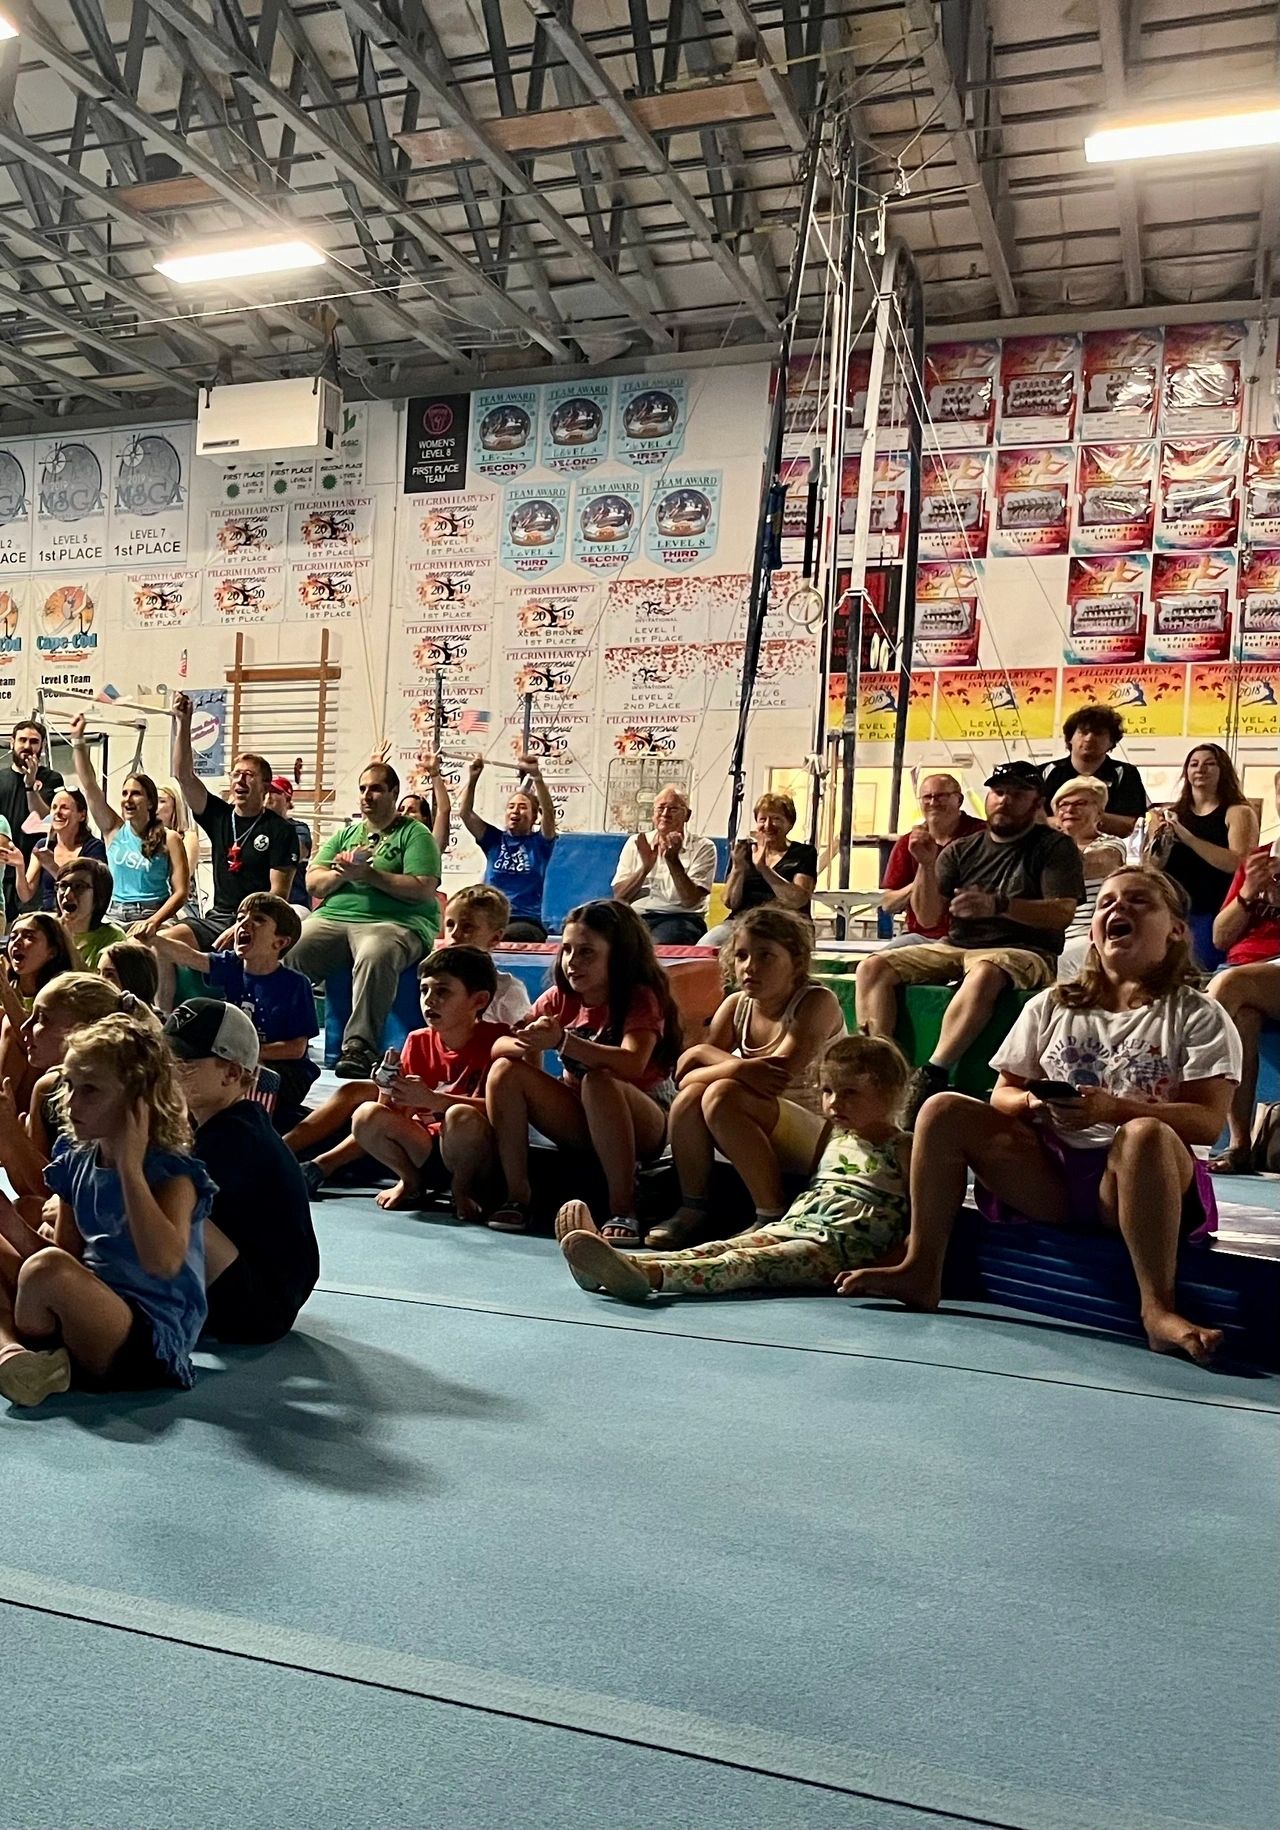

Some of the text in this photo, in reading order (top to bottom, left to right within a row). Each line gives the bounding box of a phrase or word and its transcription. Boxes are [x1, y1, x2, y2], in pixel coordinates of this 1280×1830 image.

[419, 439, 456, 449] WOMEN'S
[422, 450, 444, 459] LEVEL
[271, 469, 289, 477] FIRST
[412, 464, 459, 475] FIRST PLACE
[223, 473, 241, 481] FIRST
[425, 475, 445, 483] TEAM
[657, 476, 718, 489] TEAM AWARD
[580, 483, 640, 493] TEAM AWARD
[434, 519, 474, 531] 20 19
[130, 528, 165, 539] LEVEL 7
[6, 540, 12, 549] 2
[53, 534, 87, 545] LEVEL 5
[39, 547, 102, 562] 1st PLACE
[114, 542, 181, 557] 1st PLACE
[662, 550, 699, 559] THIRD
[410, 559, 491, 571] PILGRIM HARVEST
[514, 559, 548, 567] THIRD
[580, 555, 629, 564] SECOND
[430, 583, 471, 595] 20 19
[510, 585, 595, 596] PILGRIM HARVEST
[532, 609, 574, 621] 20 19
[406, 624, 488, 634] PILGRIM HARVEST
[36, 633, 97, 651] Cape-Cod
[428, 647, 467, 659] 20 19
[506, 650, 593, 660] PILGRIM HARVEST
[953, 670, 1045, 681] PILGRIM HARVEST
[1122, 666, 1175, 676] HARVEST
[41, 674, 91, 685] Level 8 Team
[529, 674, 571, 686] 20 19
[667, 692, 673, 700] 2
[1108, 686, 1132, 700] 2018
[606, 714, 697, 725] PILGRIM HARVEST
[970, 720, 1006, 728] LEVEL
[960, 729, 1027, 738] 3RD PLACE
[556, 740, 568, 750] 19
[629, 740, 675, 750] 20 20
[114, 849, 151, 872] USA
[494, 859, 530, 871] GRACE
